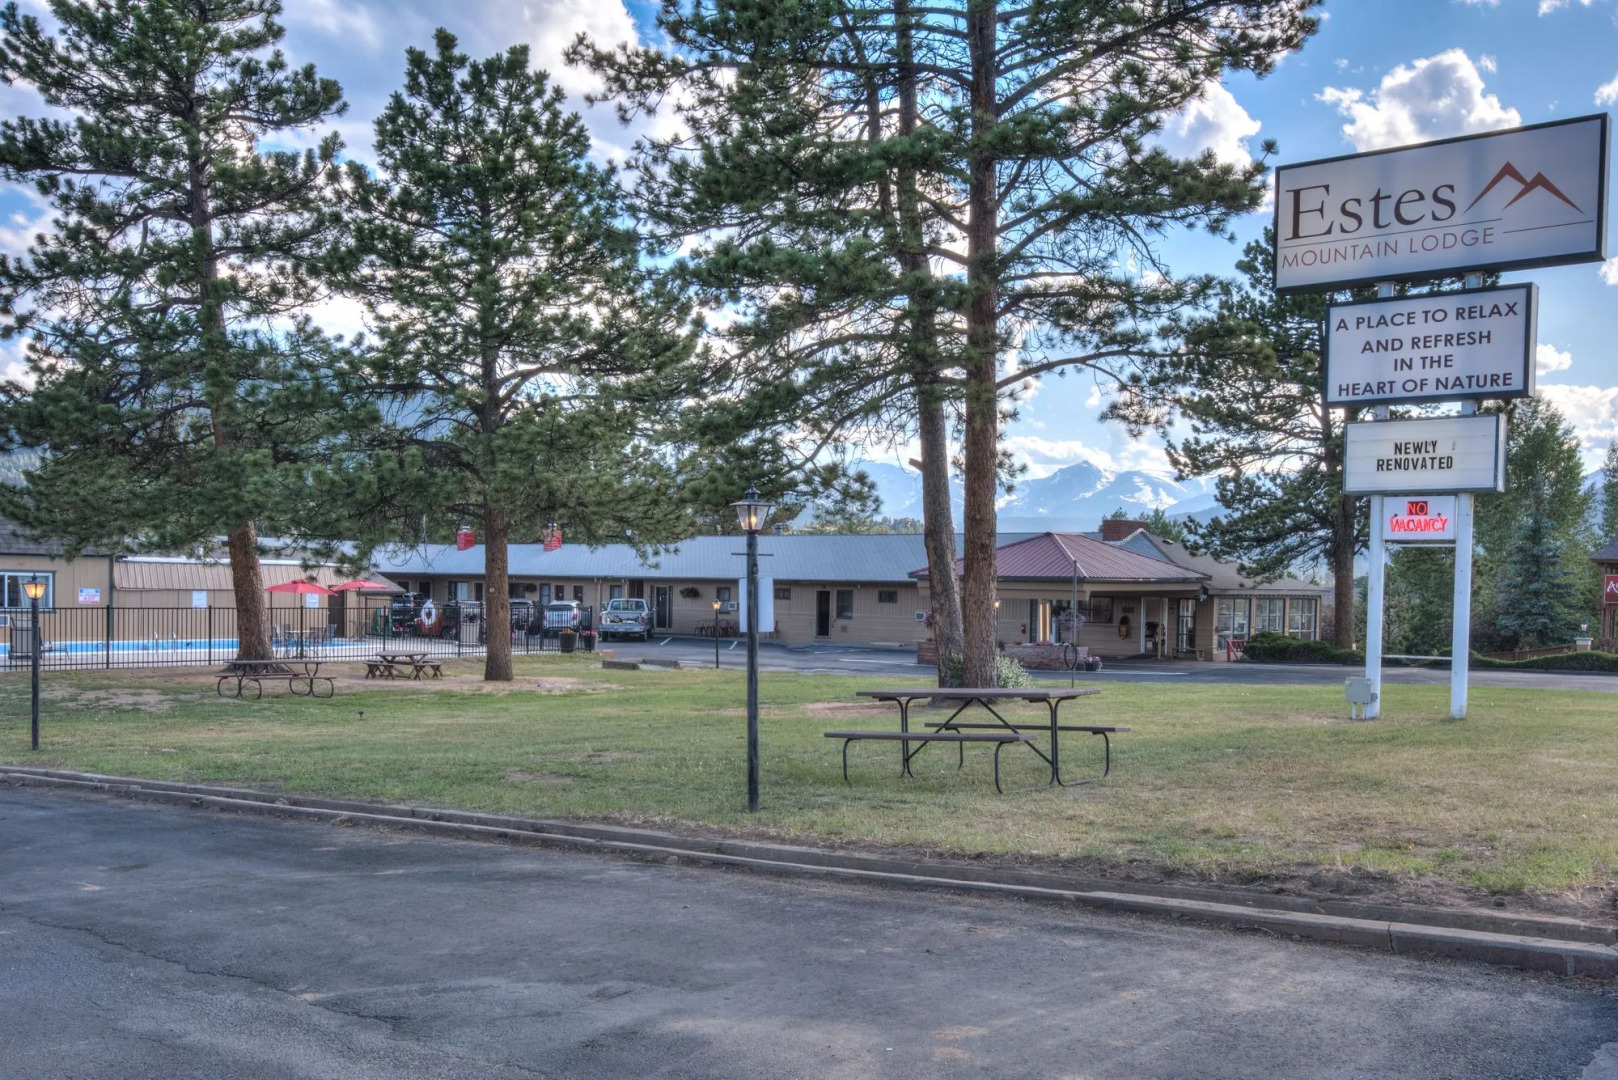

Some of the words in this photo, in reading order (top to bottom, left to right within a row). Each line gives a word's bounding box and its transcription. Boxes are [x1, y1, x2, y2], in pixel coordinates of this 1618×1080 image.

[1283, 184, 1457, 241] Estes
[1282, 240, 1398, 269] MOUNTAIN
[1409, 227, 1494, 253] LODGE
[1335, 318, 1349, 331] A
[1356, 312, 1416, 330] PLACE
[1422, 308, 1448, 324] TO
[1455, 301, 1519, 321] RELAX
[1361, 338, 1403, 354] AND
[1411, 330, 1491, 350] REFRESH
[1394, 357, 1413, 372] IN
[1420, 354, 1454, 370] THE
[1338, 380, 1396, 397] HEART
[1402, 378, 1428, 393] OF
[1435, 372, 1512, 391] NATURE
[1394, 440, 1438, 455] NEWLY
[1376, 456, 1453, 472] RENOVATED
[1407, 501, 1428, 515] NO
[1390, 517, 1448, 532] VACANCY
